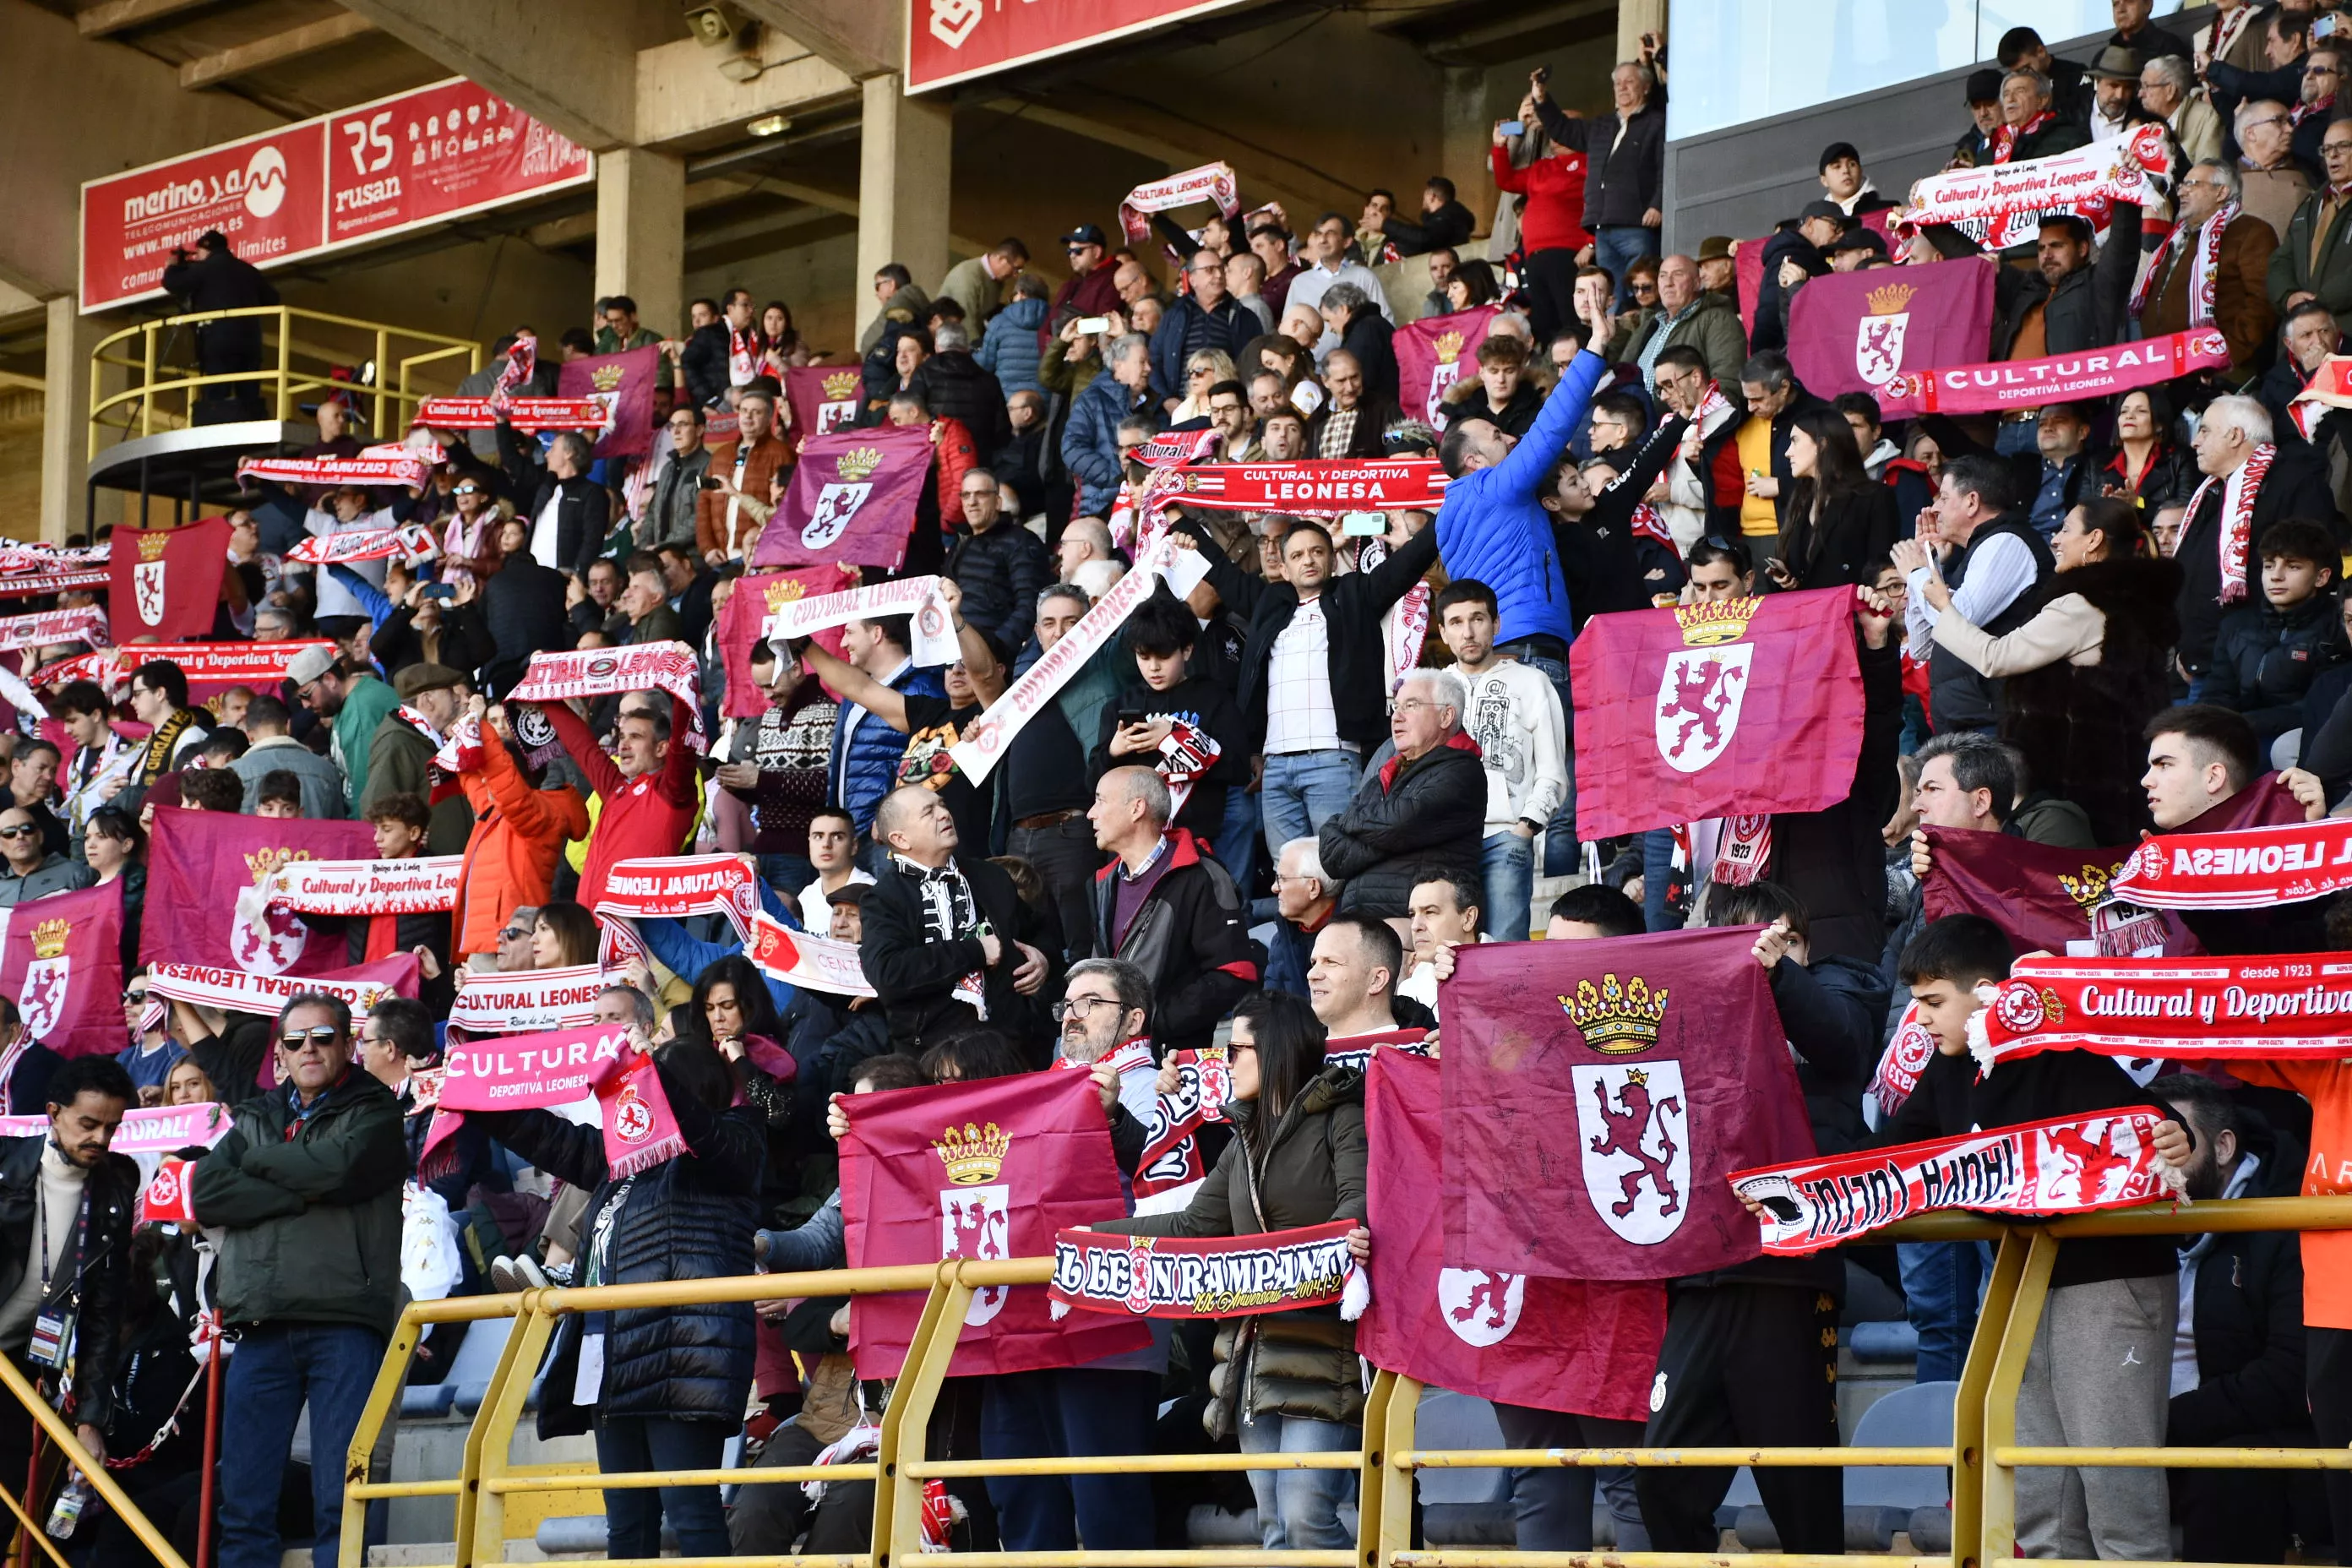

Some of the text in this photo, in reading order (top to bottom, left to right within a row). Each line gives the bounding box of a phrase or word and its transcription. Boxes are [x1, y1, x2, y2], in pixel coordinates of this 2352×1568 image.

[1994, 169, 2011, 178] Reino
[335, 176, 403, 213] rusan
[1132, 185, 1173, 199] CULTURAL
[1936, 169, 2099, 204] Cultural y Deportiva Leonesa
[125, 200, 243, 240] TELECOMUNICACIONES
[2205, 307, 2215, 315] 19
[1945, 344, 2166, 389] CULTURAL
[1999, 376, 2115, 400] DEPORTIVA LEONESA
[427, 404, 470, 416] Cultural
[471, 407, 478, 417] y
[1244, 468, 1410, 481] CULTURAL Y DEPORTIVA
[1265, 482, 1386, 500] LEONESA
[792, 576, 931, 627] CULTURAL LEONESA
[1011, 571, 1144, 713] CULTURAL LEONESA
[197, 655, 204, 669] y
[206, 653, 270, 669] Deportiva
[1731, 843, 1750, 859] 1923
[372, 863, 390, 873] Reino
[403, 863, 421, 872] León
[302, 877, 354, 894] Cultural
[356, 881, 366, 896] y
[369, 876, 432, 896] Deportiva
[818, 954, 862, 972] CENT
[2240, 965, 2312, 978] desde 1923
[155, 961, 247, 990] LEONESA
[455, 983, 612, 1010] CULTURAL LEONES
[2080, 984, 2352, 1025] Cultural y Deportiva
[529, 1015, 537, 1025] de
[446, 1031, 627, 1078] CULTURAL
[489, 1074, 589, 1098] DEPORTIVA LEONESA
[1180, 1239, 1355, 1304] RAMPANT
[1193, 1292, 1216, 1315] XX
[1217, 1287, 1282, 1313] Aniversario
